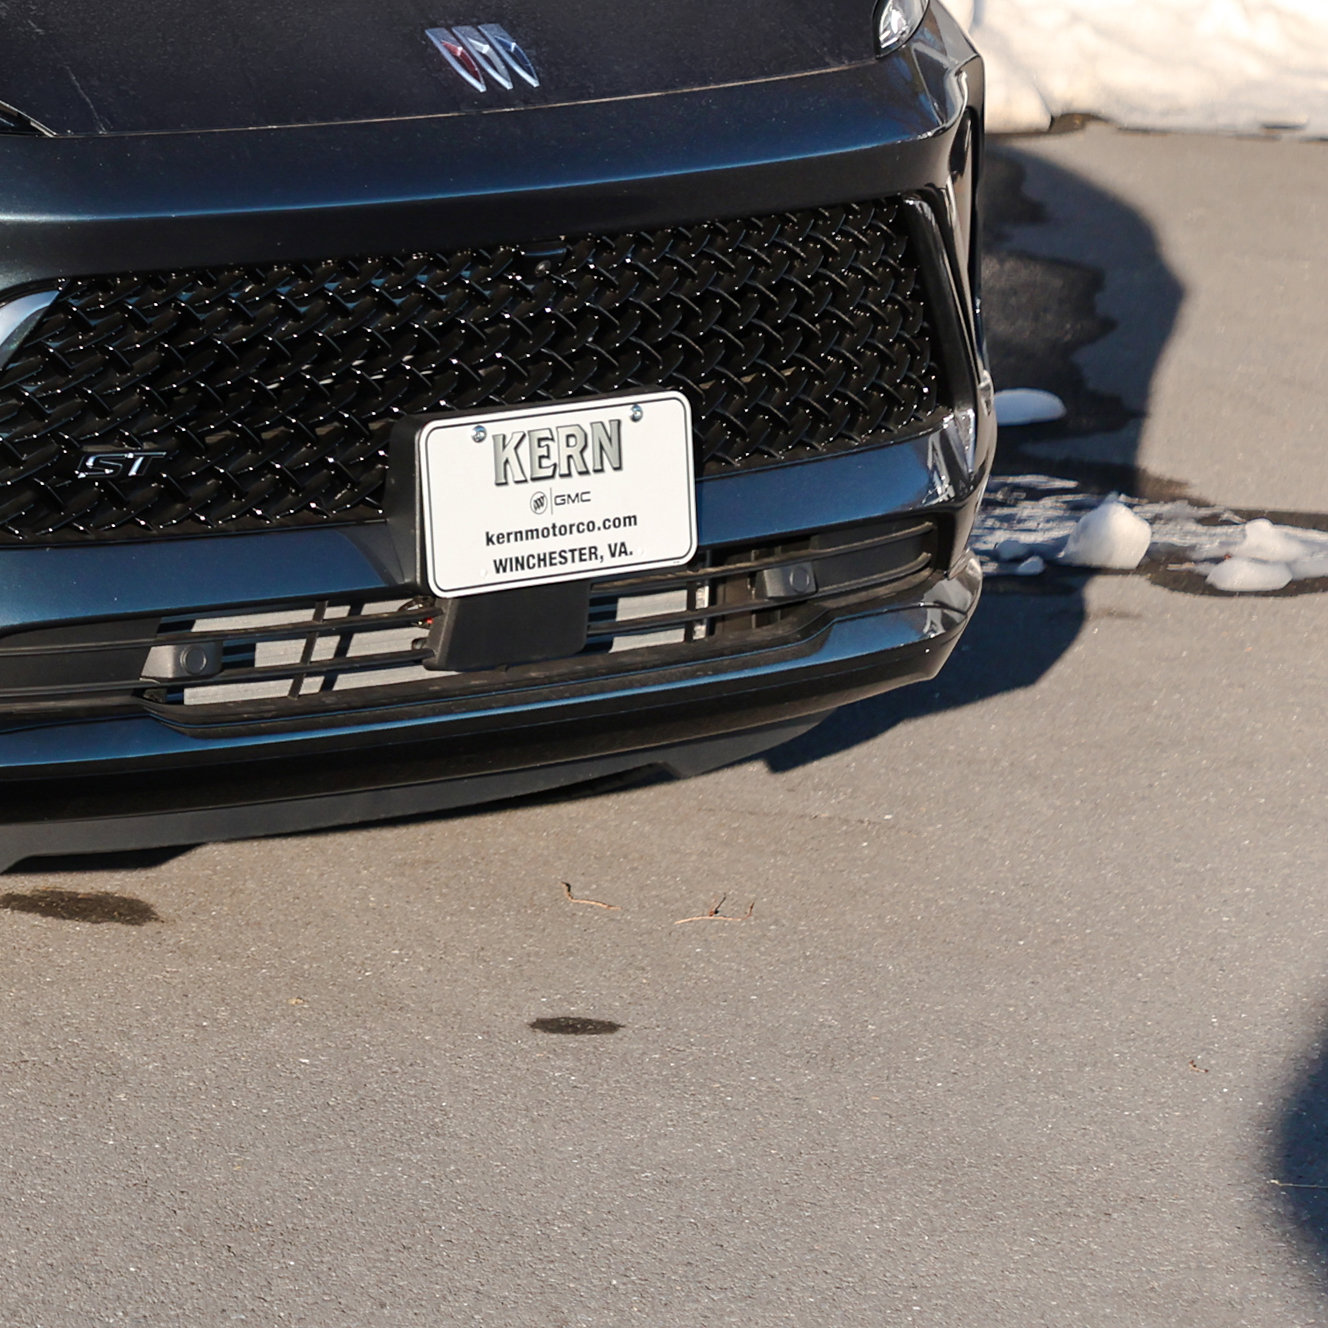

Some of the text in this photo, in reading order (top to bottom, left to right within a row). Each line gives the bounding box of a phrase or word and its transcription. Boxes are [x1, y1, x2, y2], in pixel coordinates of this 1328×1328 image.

[75, 451, 167, 479] ST
[492, 419, 623, 486] KERN
[553, 491, 592, 506] GMC
[484, 514, 638, 547] kernmotorco.com
[492, 541, 633, 574] WINCHESTER, VA.
